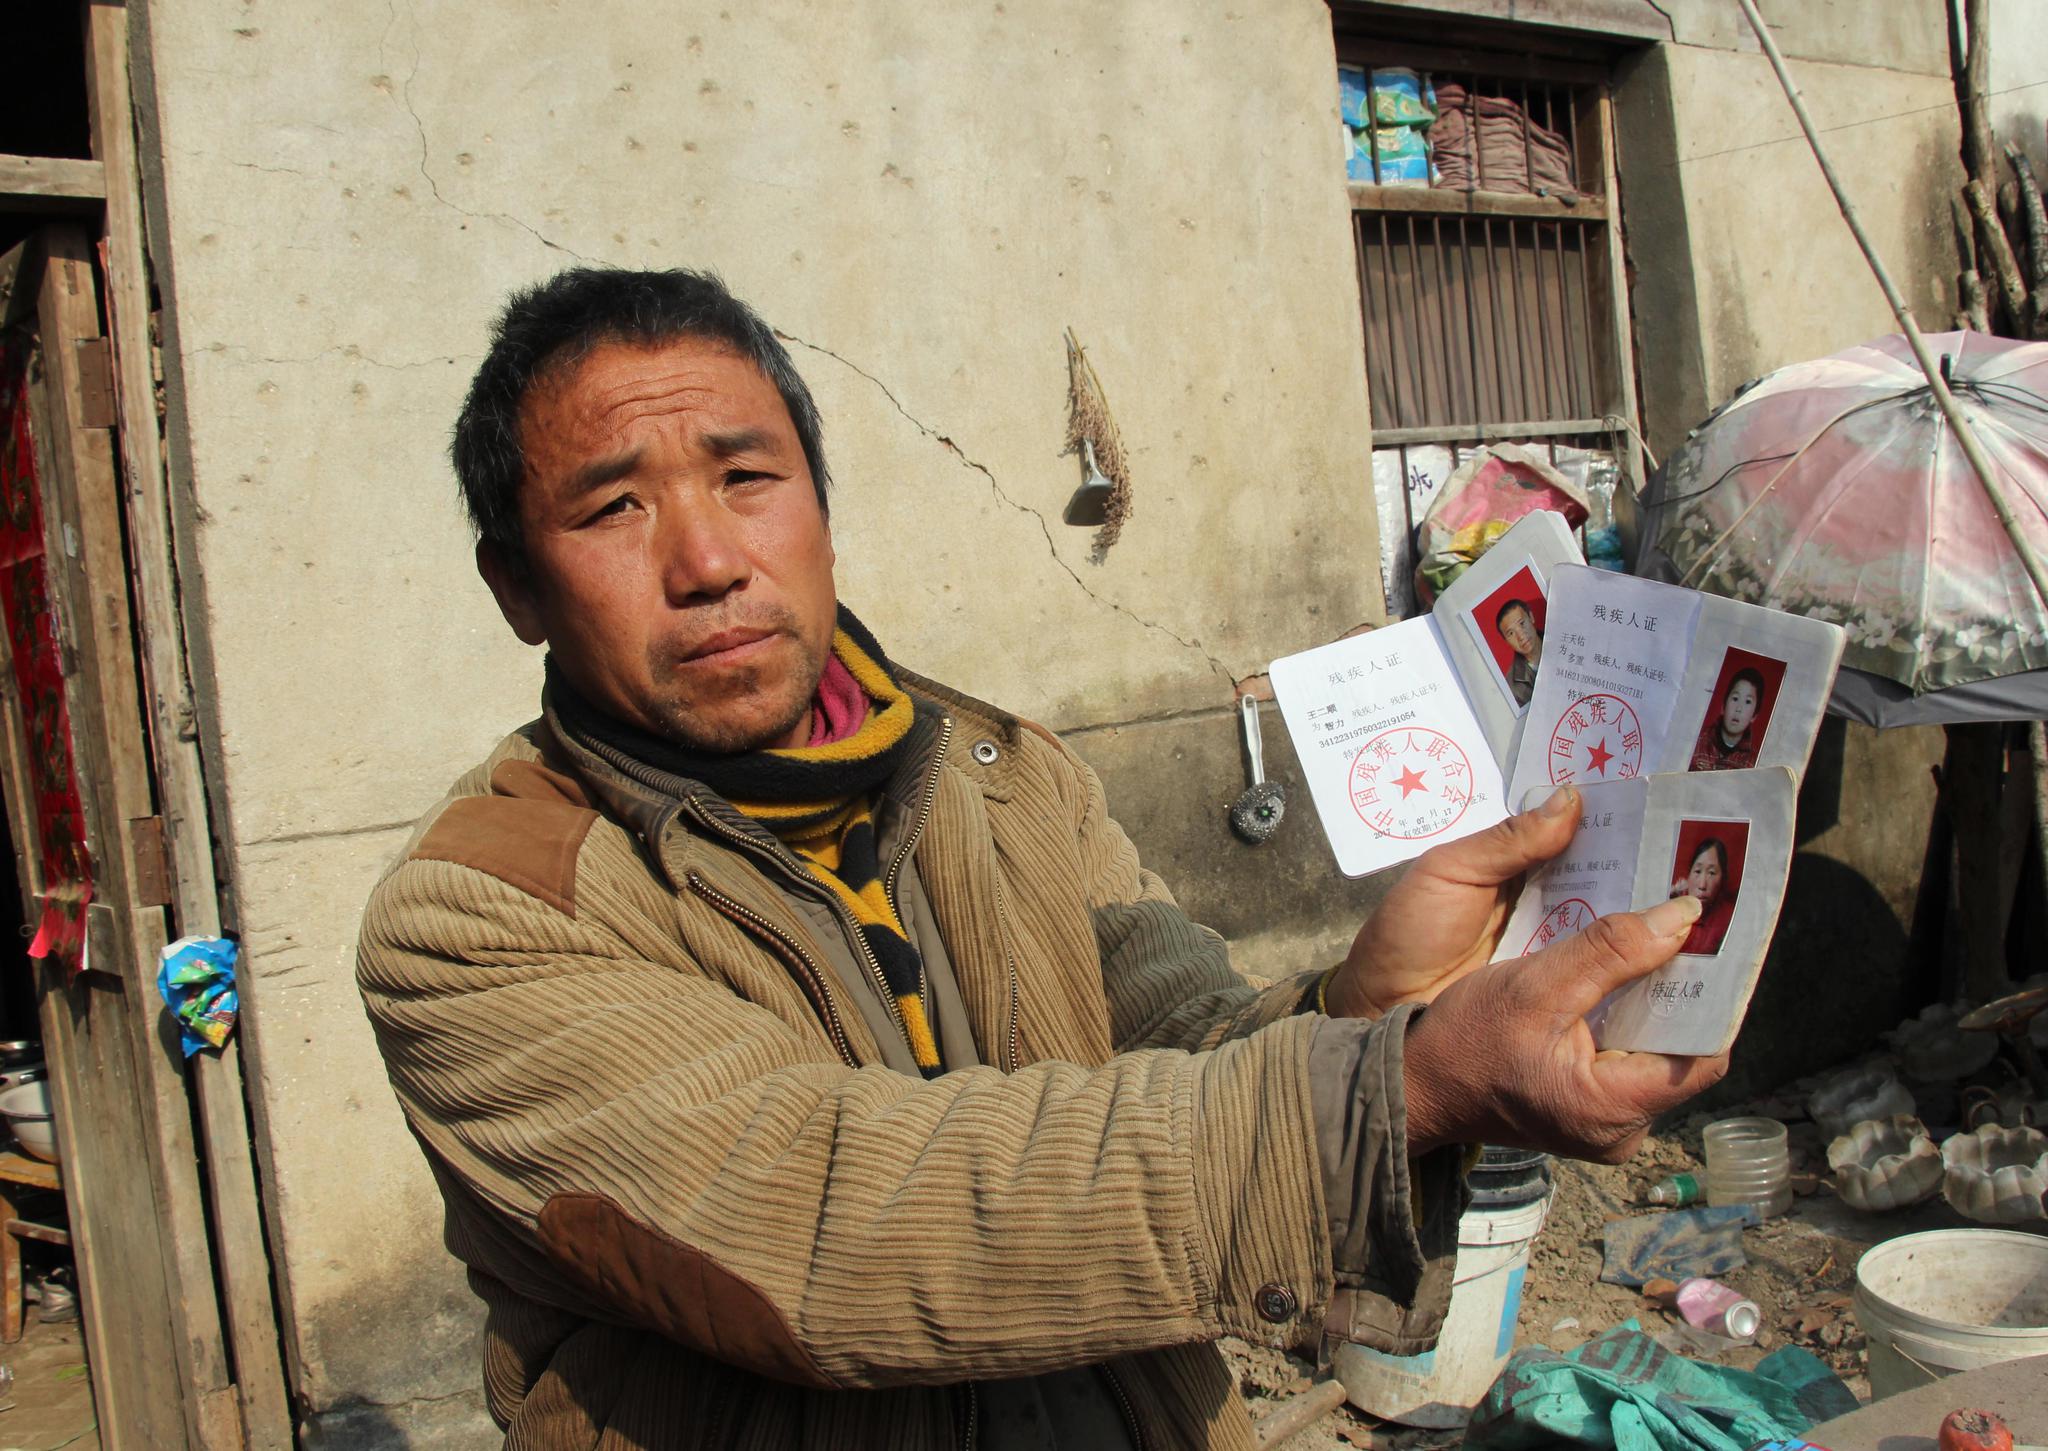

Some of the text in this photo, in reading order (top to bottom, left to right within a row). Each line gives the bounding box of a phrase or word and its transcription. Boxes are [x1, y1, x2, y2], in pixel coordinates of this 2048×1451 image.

[1593, 604, 1658, 632] 残疾人证
[1328, 652, 1402, 686] 残疾人证
[1307, 703, 1338, 720] 王二顺
[1324, 719, 1345, 731] 智力
[1354, 731, 1467, 828] 中国残疾人联合会
[1373, 828, 1392, 840] 2017
[1416, 816, 1425, 825] 07
[1429, 808, 1438, 818] 月
[1443, 807, 1452, 816] 17
[1404, 817, 1451, 840] 有效期十年
[1651, 980, 1704, 999] 持证人像
